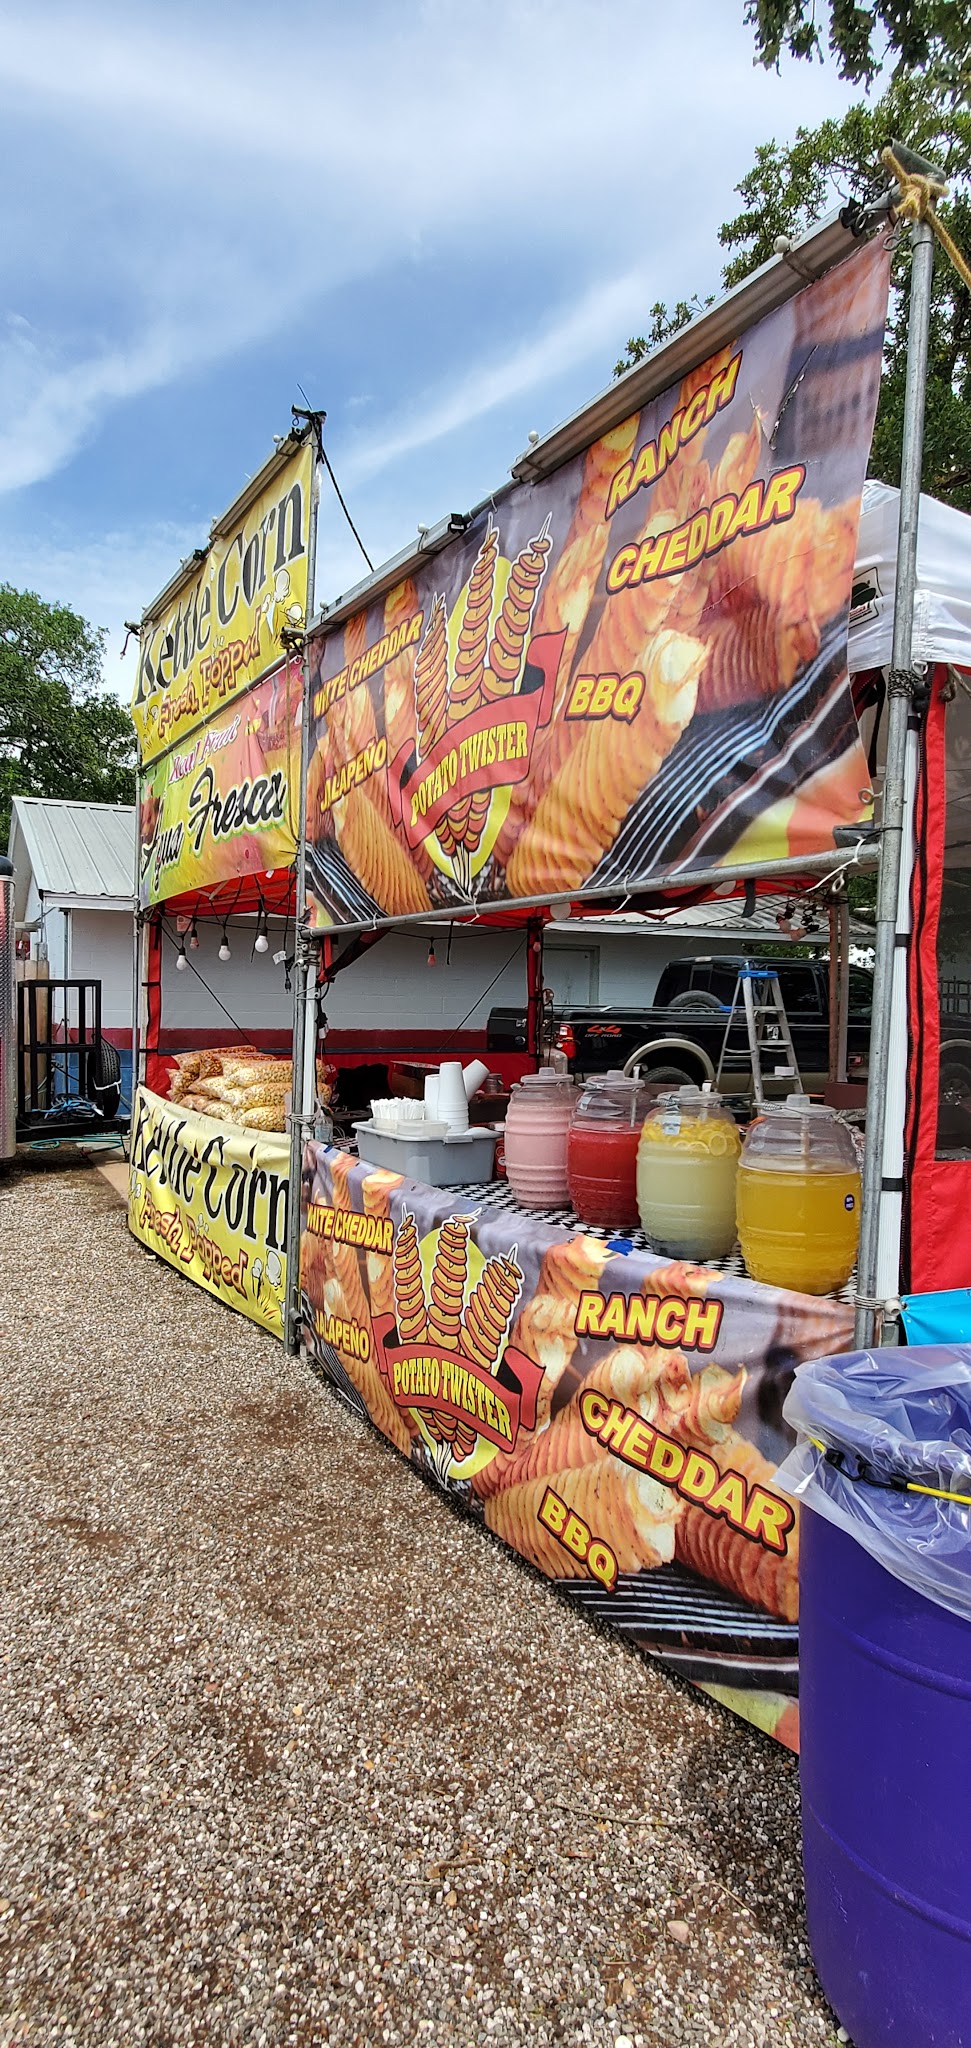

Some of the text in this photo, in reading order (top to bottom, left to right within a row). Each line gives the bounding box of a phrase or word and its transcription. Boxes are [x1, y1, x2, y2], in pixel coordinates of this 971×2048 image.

[604, 350, 743, 522] RANCH
[606, 464, 806, 594] CHEDDAR
[134, 482, 306, 705] Kettle Corn
[350, 610, 424, 692] CHEDDAR
[158, 671, 199, 738] Fresh
[564, 671, 648, 724] BBQ
[169, 714, 241, 784] Real Fruit
[410, 721, 528, 828] POTATO TWISTER
[188, 765, 287, 852] Fresca
[202, 1135, 289, 1253] Corn
[334, 1208, 394, 1255] CHEDDAR
[180, 1213, 249, 1301] Popped
[314, 1308, 370, 1364] JALAPEÑO
[573, 1290, 724, 1352] RANCH
[393, 1358, 513, 1444] POTATO TWISTER
[579, 1389, 796, 1556] CHEDDAR
[538, 1486, 619, 1594] BBQ
